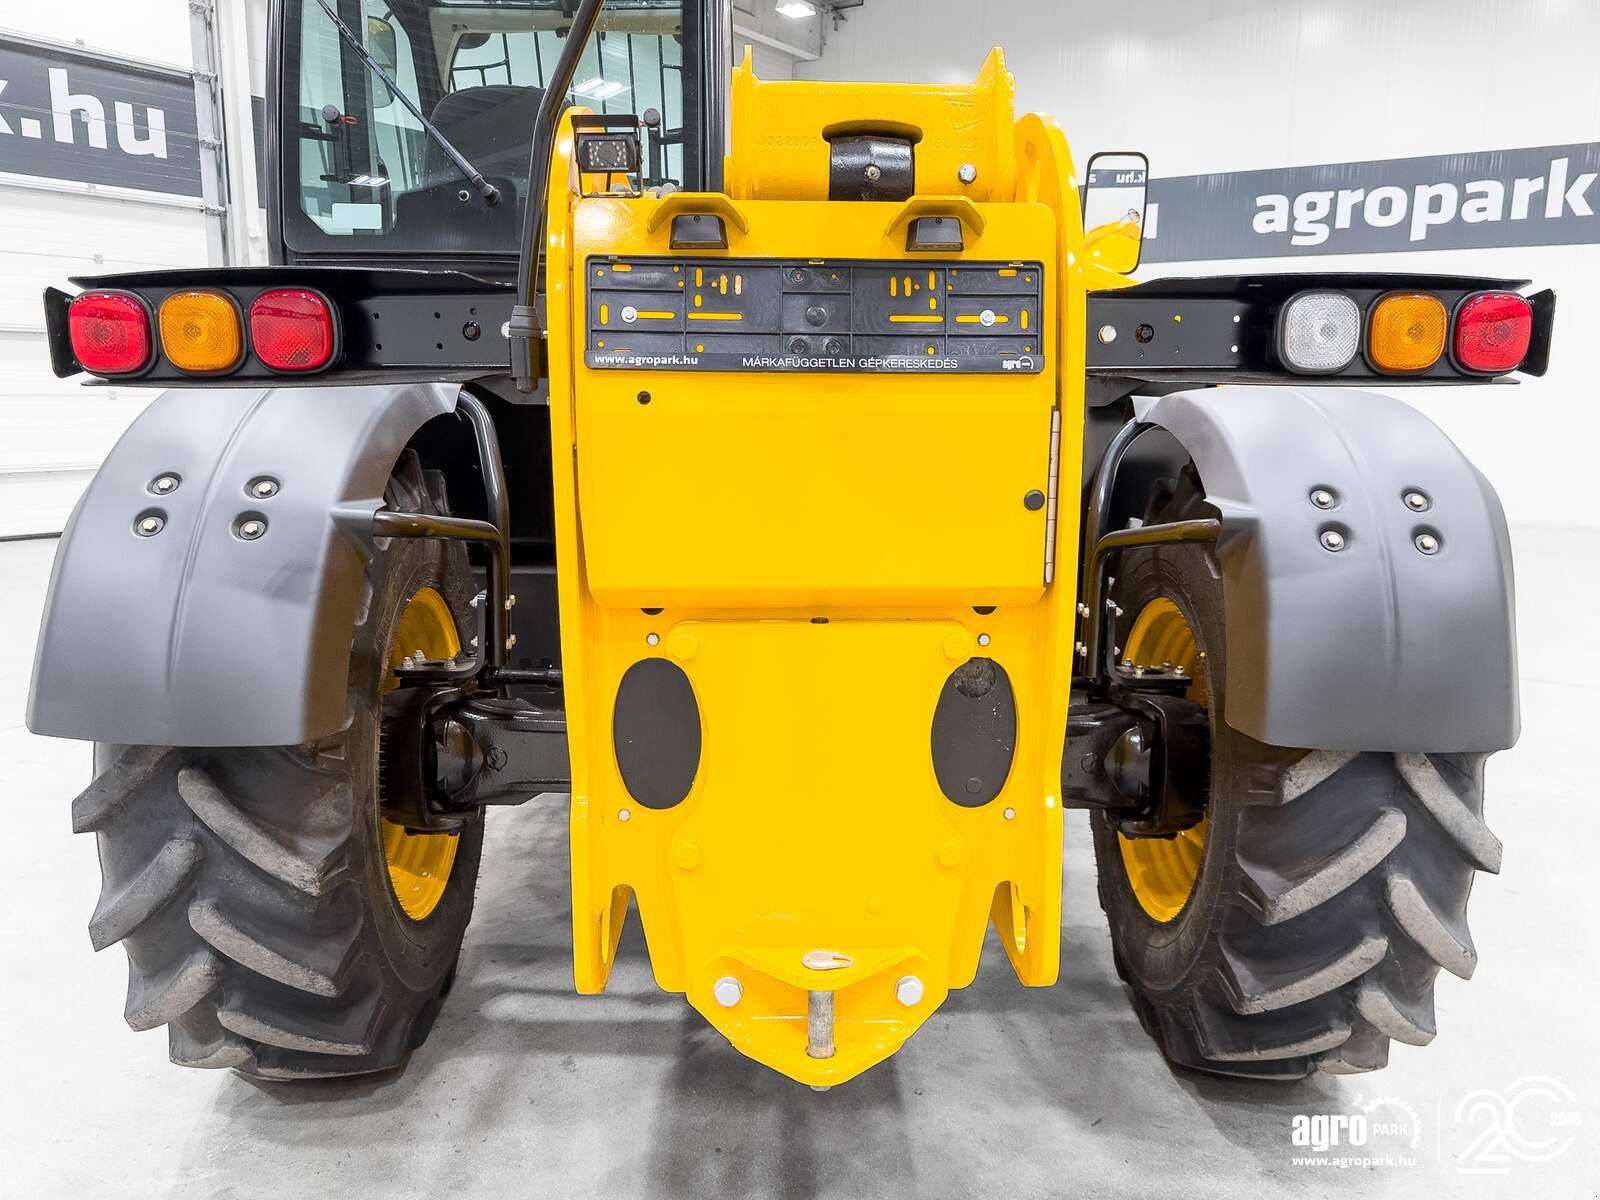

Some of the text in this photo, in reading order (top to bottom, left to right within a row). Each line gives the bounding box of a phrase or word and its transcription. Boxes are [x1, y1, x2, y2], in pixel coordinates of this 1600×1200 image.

[0, 67, 168, 159] .hu
[1252, 157, 1599, 246] agropark
[594, 355, 699, 367] www.agropark.hu
[742, 356, 855, 368] MÁRKAFÜGGETLEN
[858, 356, 958, 369] GÉPKERESKEDÉS
